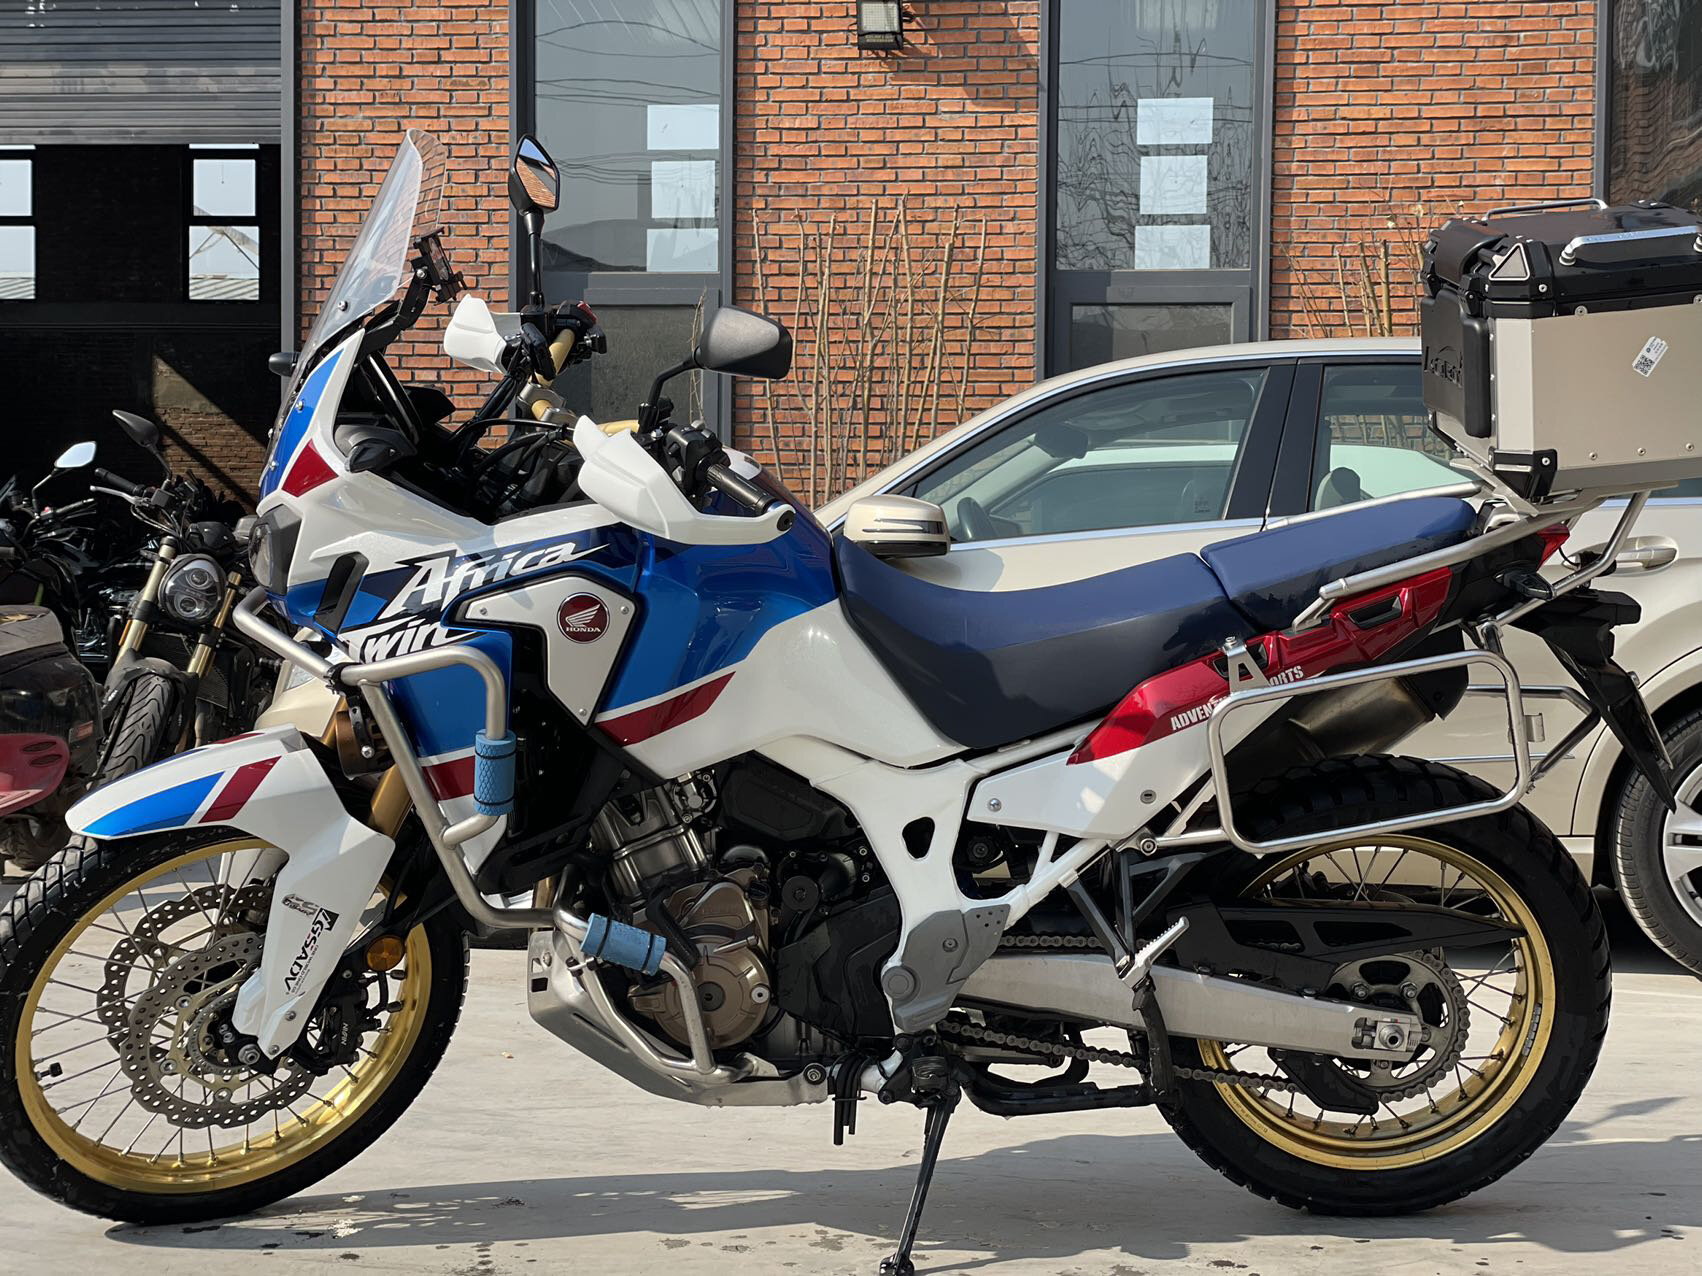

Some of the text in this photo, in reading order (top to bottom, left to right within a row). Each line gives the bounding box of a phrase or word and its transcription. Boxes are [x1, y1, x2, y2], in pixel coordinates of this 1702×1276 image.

[377, 542, 610, 620] Africa
[338, 615, 480, 664] Twin
[1170, 666, 1304, 731] ADVEN ORTS
[284, 919, 324, 991] GSADV
